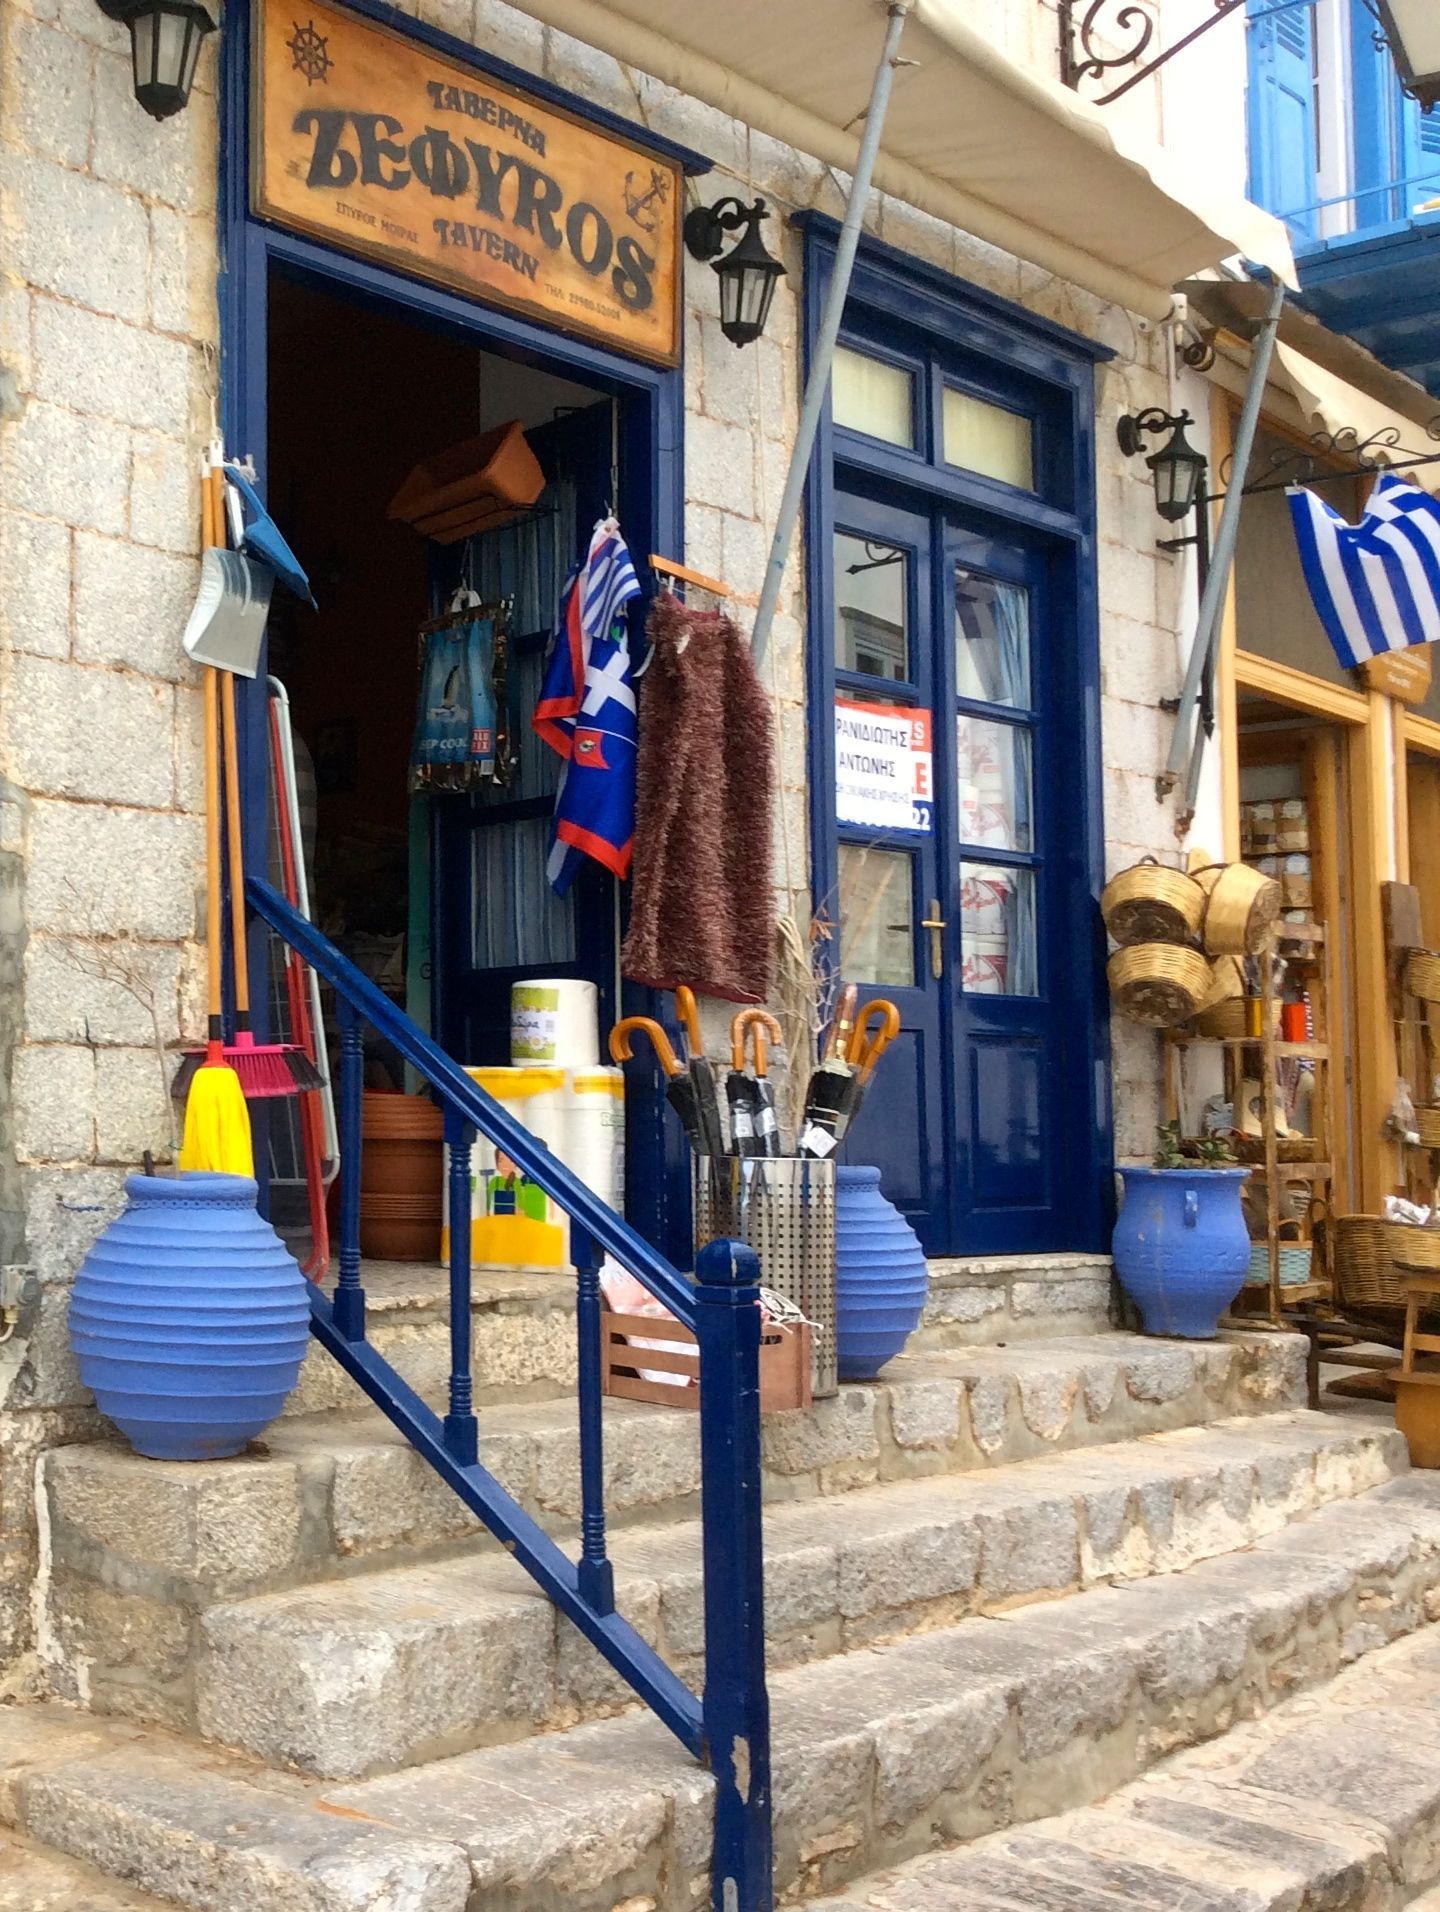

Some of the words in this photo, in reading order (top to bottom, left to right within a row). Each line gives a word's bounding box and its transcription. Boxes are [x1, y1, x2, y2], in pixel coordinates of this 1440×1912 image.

[426, 80, 547, 159] ΤΑΒΕΡΝΑ
[432, 217, 540, 283] TAVERN
[839, 751, 896, 778] ΑΝΤΩΝΗΣ
